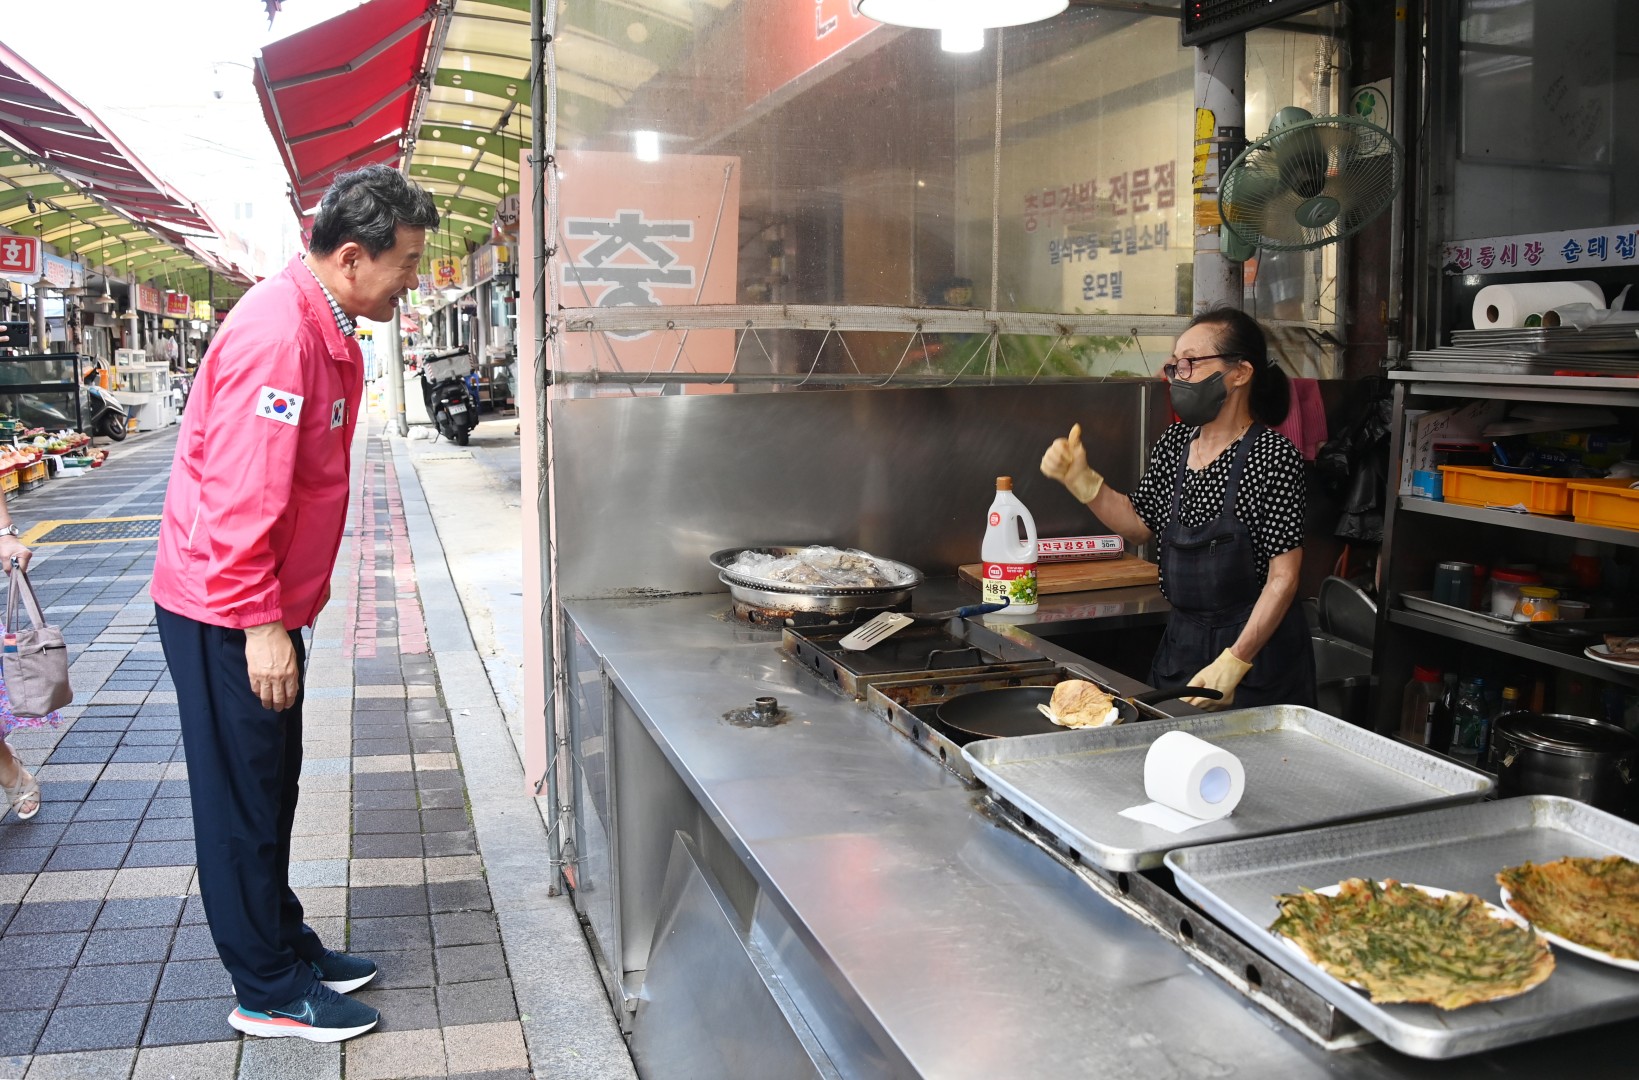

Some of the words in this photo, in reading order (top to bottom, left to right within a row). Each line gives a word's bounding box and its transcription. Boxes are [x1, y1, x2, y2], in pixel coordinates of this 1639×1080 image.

[1108, 160, 1176, 216] 전문점
[2, 238, 32, 270] 회
[1108, 220, 1170, 256] 모밀소바
[1454, 240, 1544, 270] 전통시장
[1560, 231, 1638, 263] 순대집
[1082, 270, 1123, 301] 온모밀
[985, 583, 1008, 595] 식용유
